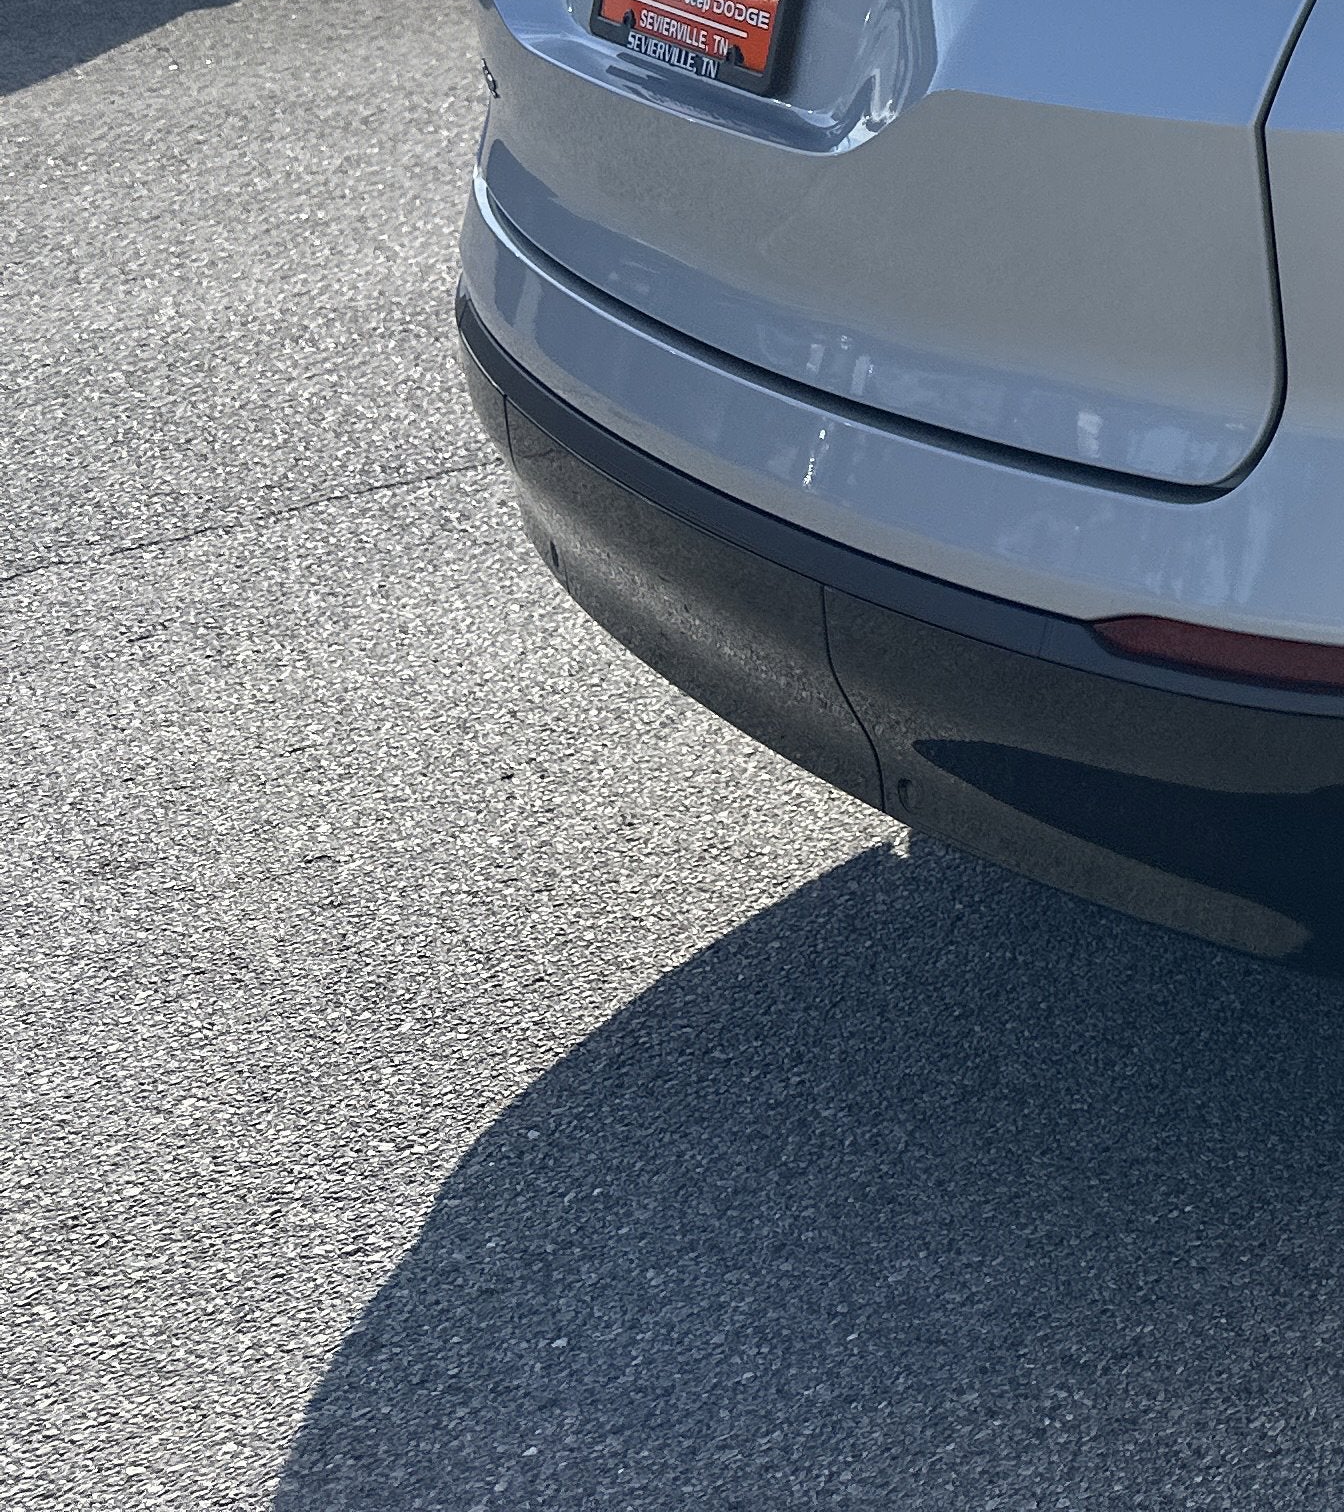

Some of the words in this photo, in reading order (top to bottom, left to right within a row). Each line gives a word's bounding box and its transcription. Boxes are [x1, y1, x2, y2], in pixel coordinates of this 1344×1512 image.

[626, 31, 697, 73] SEVIERVILLE,
[701, 57, 719, 79] TN
[639, 9, 708, 53] SEVIERVILLE,
[713, 34, 729, 57] TN
